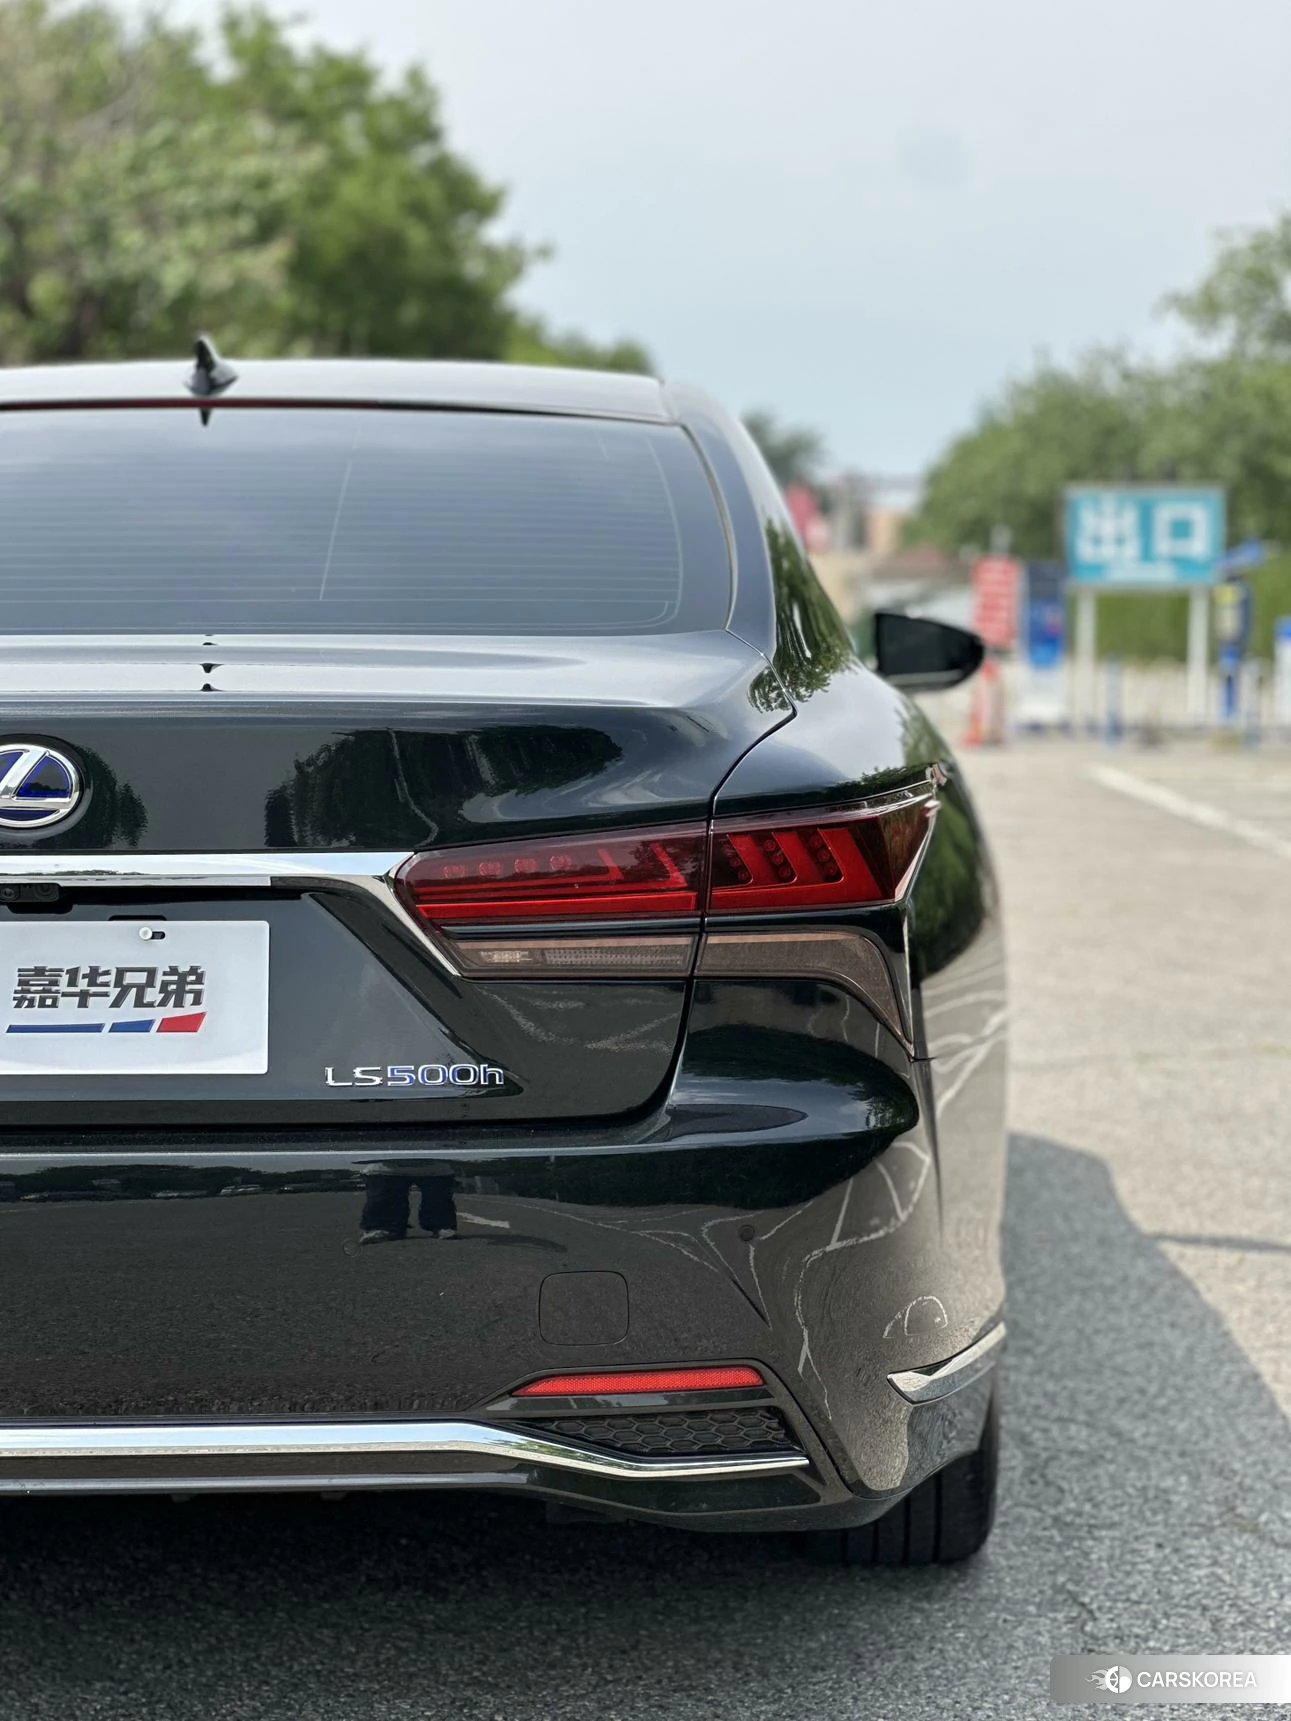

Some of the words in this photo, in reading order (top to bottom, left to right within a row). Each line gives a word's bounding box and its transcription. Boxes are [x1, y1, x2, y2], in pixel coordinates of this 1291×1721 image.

[1077, 497, 1208, 562] 出口
[13, 966, 207, 1009] 嘉华兄弟
[325, 1064, 504, 1086] LS500h
